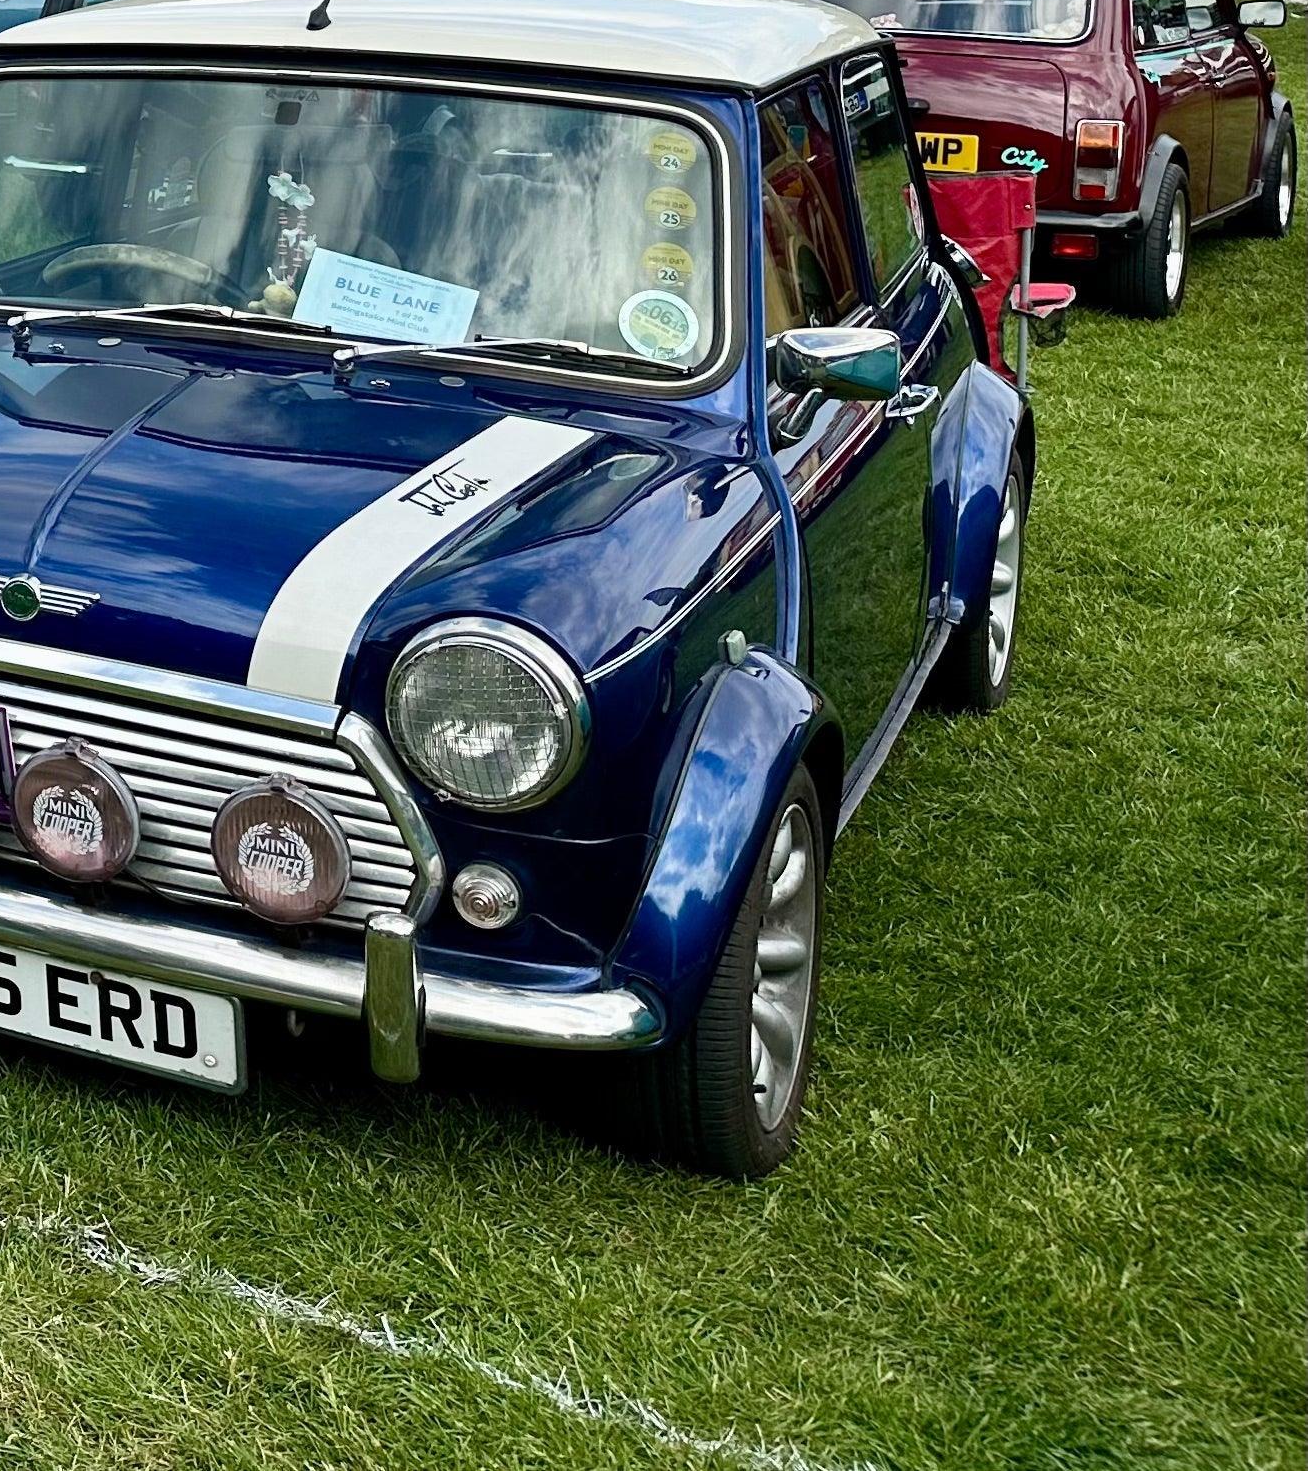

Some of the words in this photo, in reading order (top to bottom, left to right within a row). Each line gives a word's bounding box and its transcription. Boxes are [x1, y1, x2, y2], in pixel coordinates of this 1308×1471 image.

[662, 156, 679, 169] 24
[1001, 146, 1049, 174] City
[662, 212, 679, 225] 25
[335, 276, 382, 299] BLUE
[392, 292, 441, 314] LANE
[649, 305, 674, 325] 06
[45, 797, 86, 820] MINI
[41, 812, 94, 842] COOPER
[255, 836, 295, 857] MINI
[247, 849, 304, 879] COOPER
[45, 963, 198, 1060] ERD
